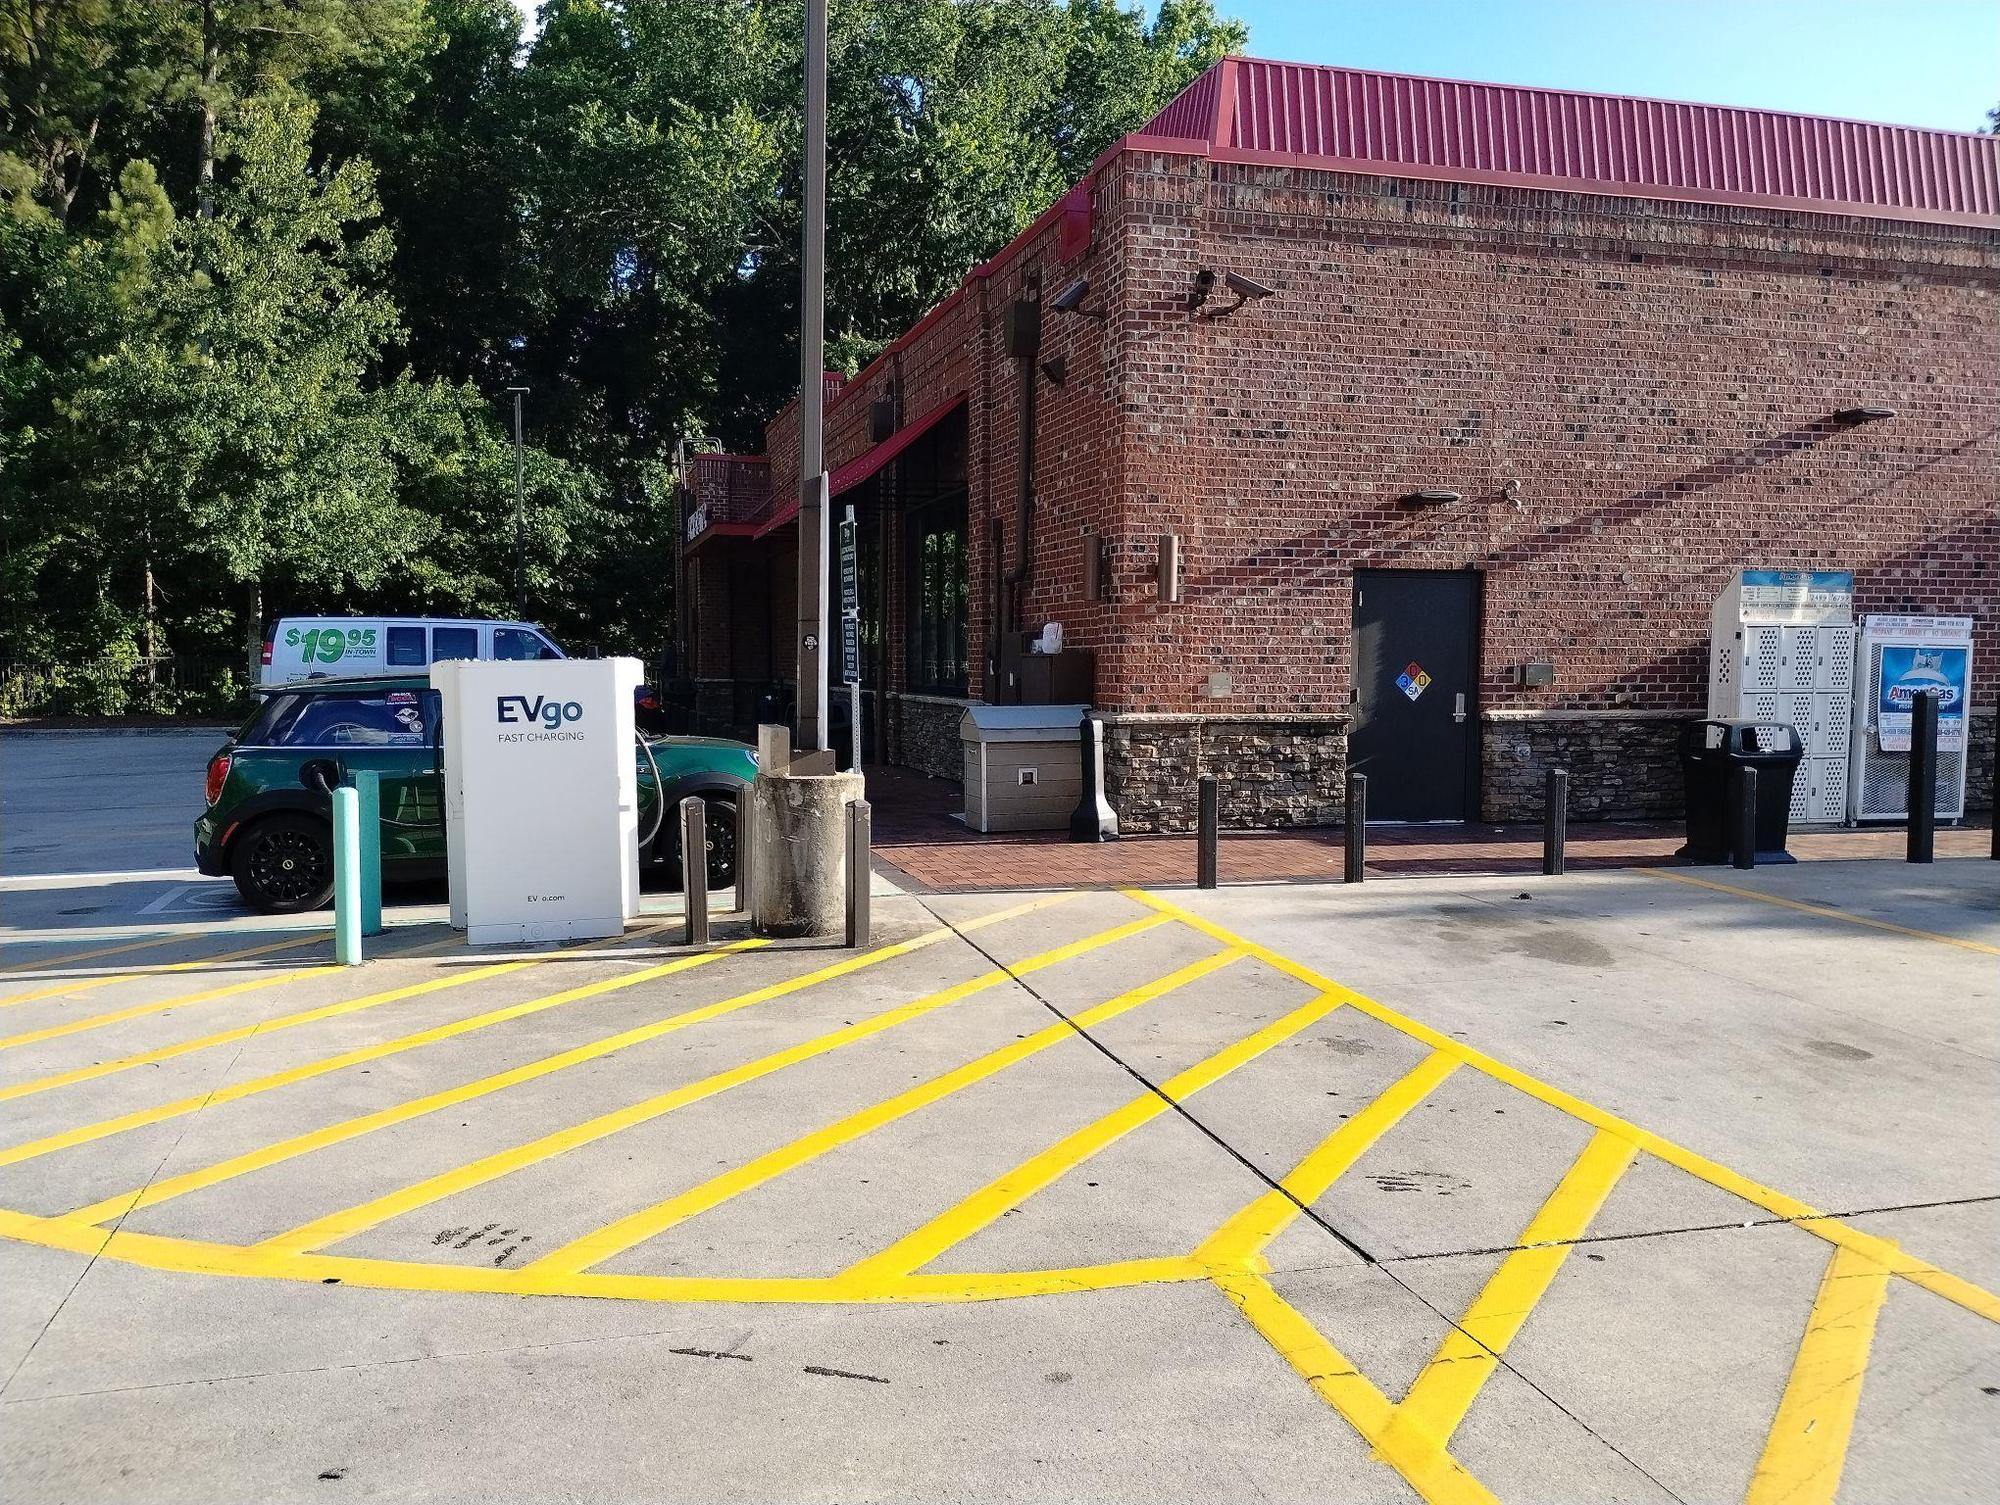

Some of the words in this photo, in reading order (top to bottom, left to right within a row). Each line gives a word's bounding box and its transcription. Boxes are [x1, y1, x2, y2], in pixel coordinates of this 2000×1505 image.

[1401, 676, 1408, 687] 3
[1419, 675, 1426, 686] 0
[1409, 687, 1419, 695] SA
[497, 695, 583, 729] EVgo
[498, 733, 525, 743] FAST
[526, 731, 585, 742] CHARGING
[527, 895, 566, 903] EVo.com
